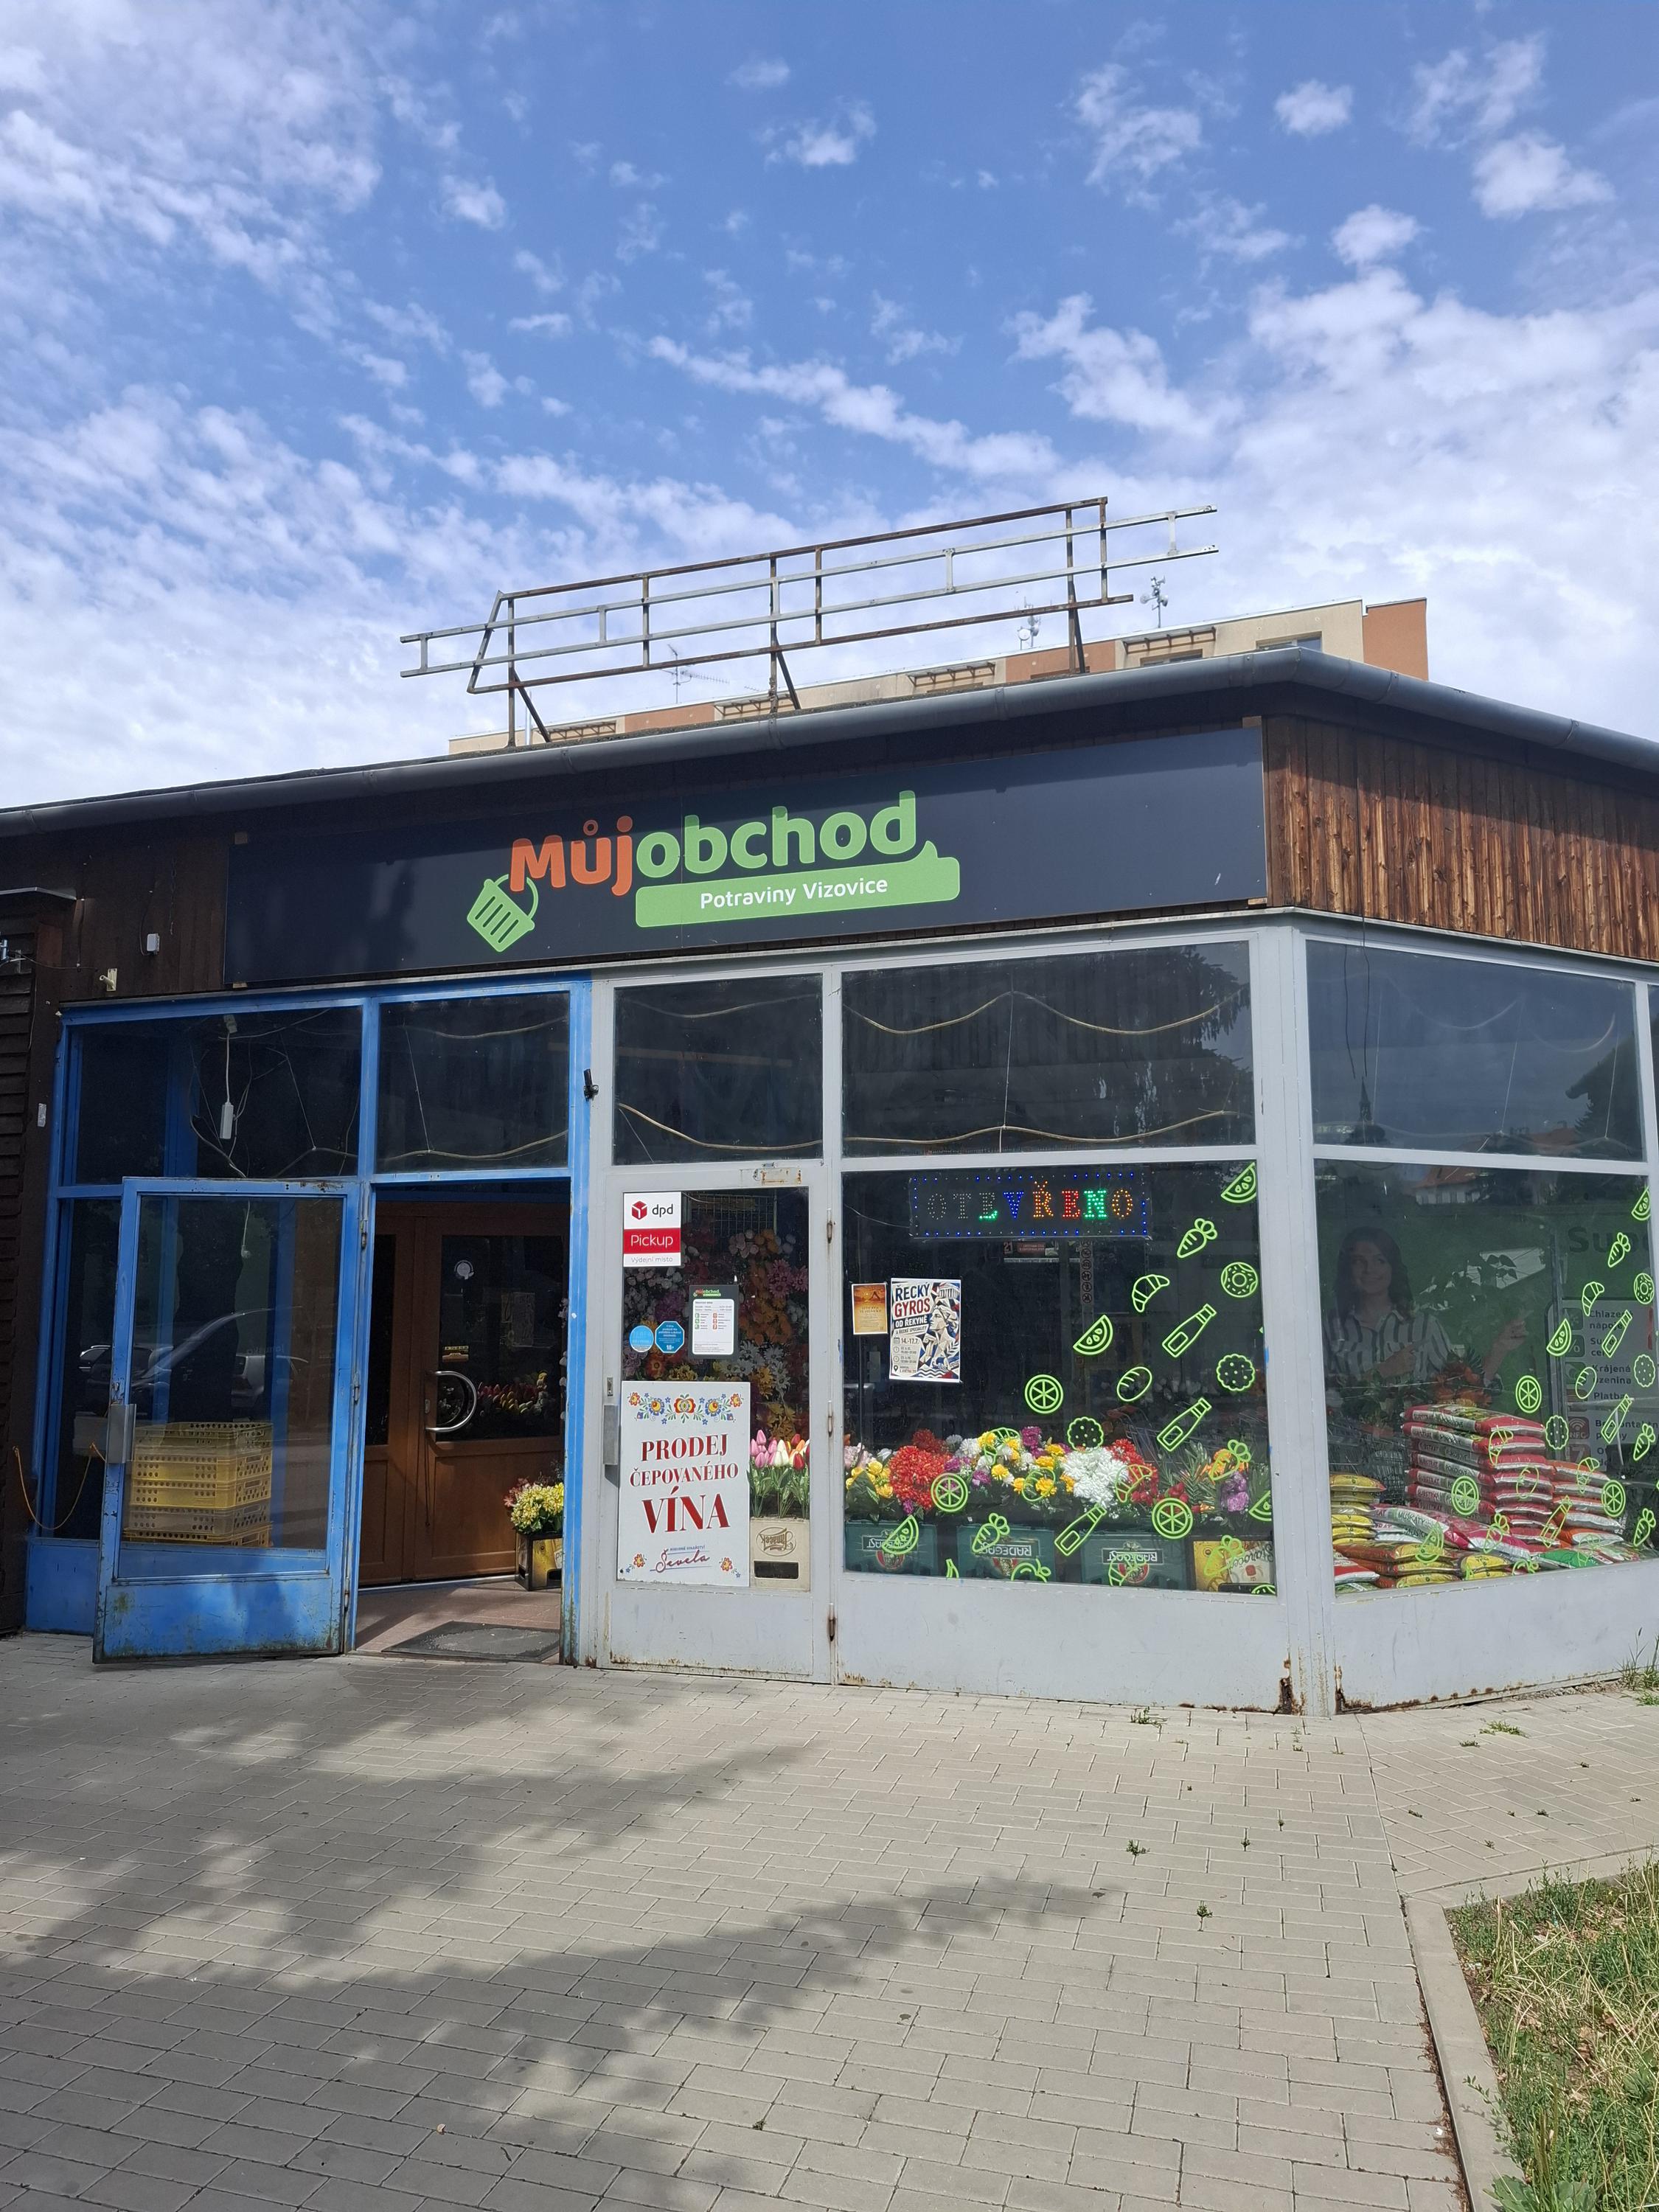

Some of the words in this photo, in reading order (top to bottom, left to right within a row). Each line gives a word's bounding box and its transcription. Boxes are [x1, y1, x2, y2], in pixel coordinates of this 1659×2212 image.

[700, 886, 797, 909] Potraviny
[802, 877, 888, 900] Vizovice
[652, 1204, 674, 1218] dpd
[926, 1180, 1134, 1221] OTEVŘENO
[630, 1234, 674, 1249] Pickup
[895, 1281, 931, 1301] ŘECKÝ
[894, 1298, 931, 1318] GYROS
[895, 1320, 903, 1328] OD
[641, 1434, 728, 1462] PRODEJ
[630, 1461, 739, 1487] ČEPOVANÉHO
[641, 1486, 731, 1534] VÍNA
[655, 1548, 710, 1573] Ševela
